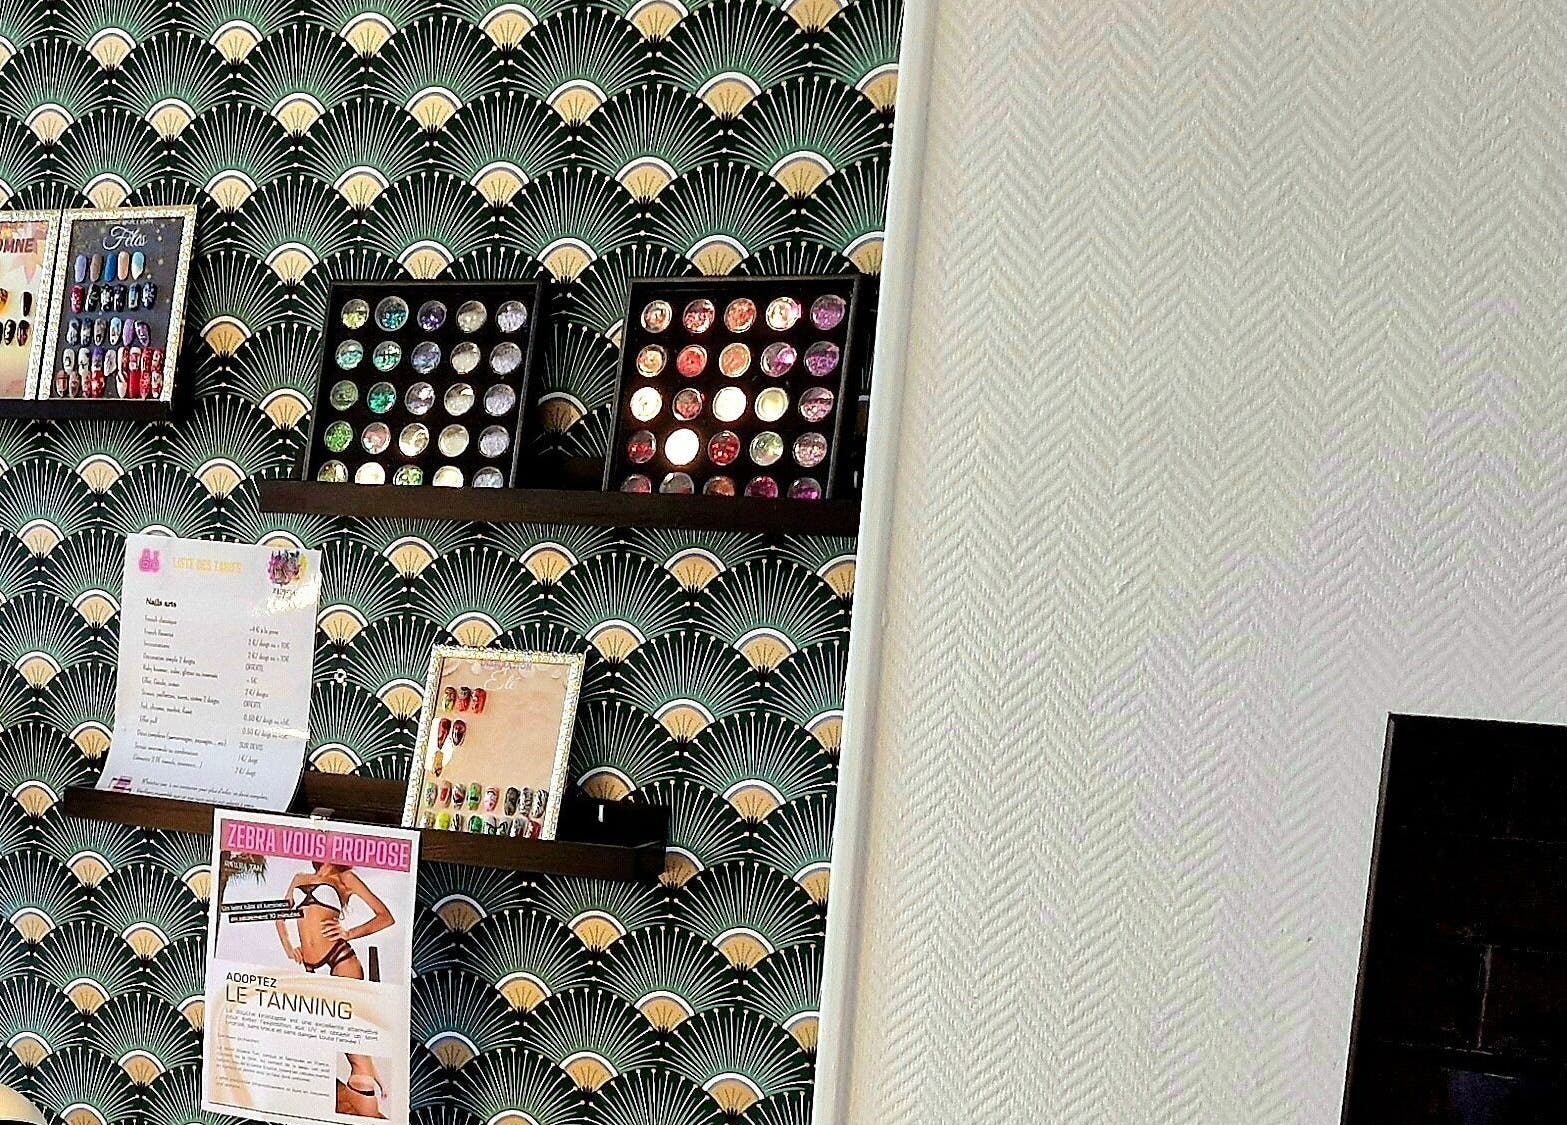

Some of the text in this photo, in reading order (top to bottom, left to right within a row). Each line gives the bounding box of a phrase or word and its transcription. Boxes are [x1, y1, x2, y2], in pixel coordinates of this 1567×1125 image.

[227, 823, 410, 868] ZEBRA VOUS PROPOSE
[226, 972, 277, 988] ADOPTEZ
[226, 984, 352, 1020] LE TANNING
